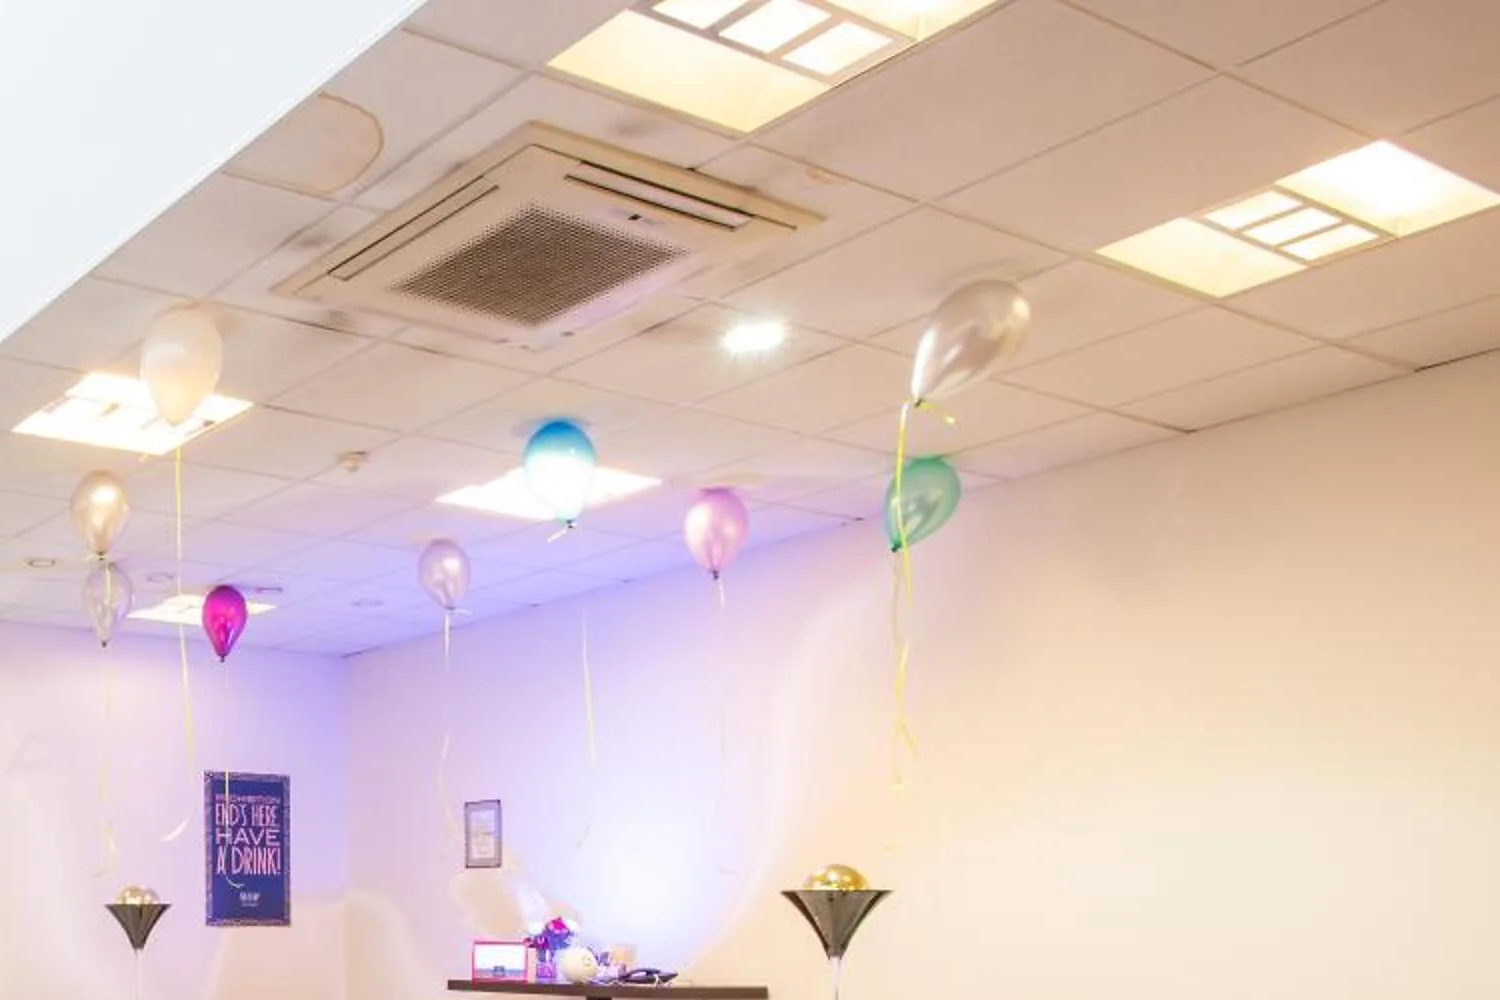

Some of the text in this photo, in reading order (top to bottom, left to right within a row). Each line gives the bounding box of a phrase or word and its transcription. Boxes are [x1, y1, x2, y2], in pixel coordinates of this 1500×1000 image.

[215, 828, 280, 846] HAVE
[216, 846, 281, 876] A DRINK!
